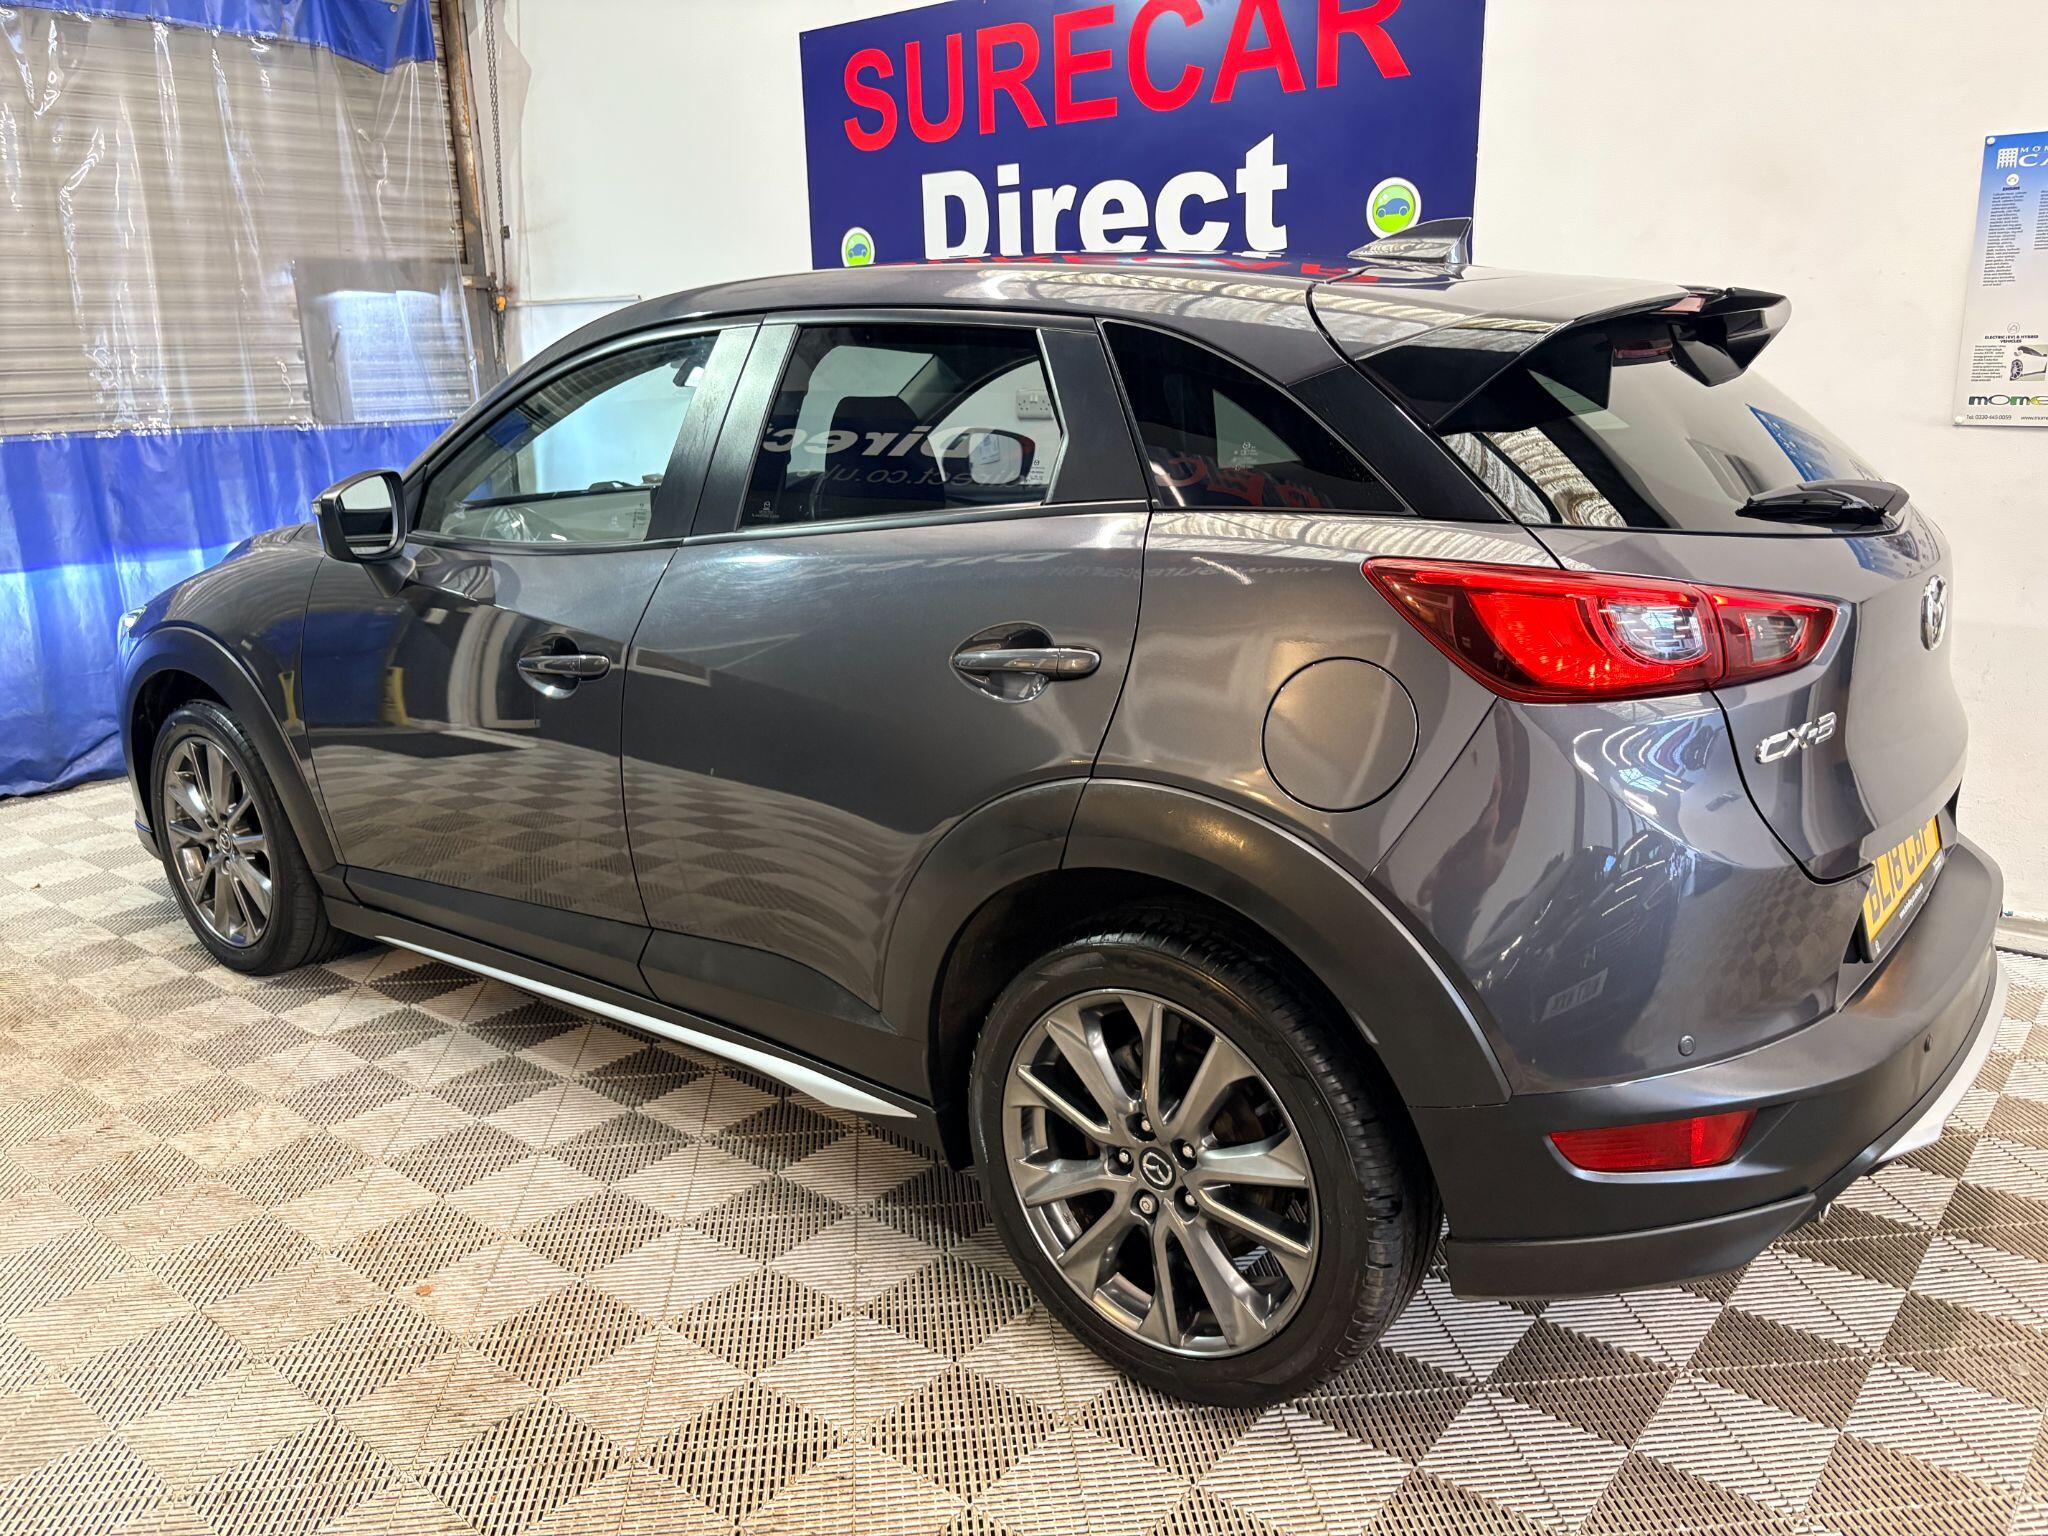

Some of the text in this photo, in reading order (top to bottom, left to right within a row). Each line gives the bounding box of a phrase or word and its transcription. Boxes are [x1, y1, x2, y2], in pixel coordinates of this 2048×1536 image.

[844, 0, 1411, 152] SURECAR
[921, 132, 1289, 260] Direct
[1755, 711, 1837, 764] CX-3
